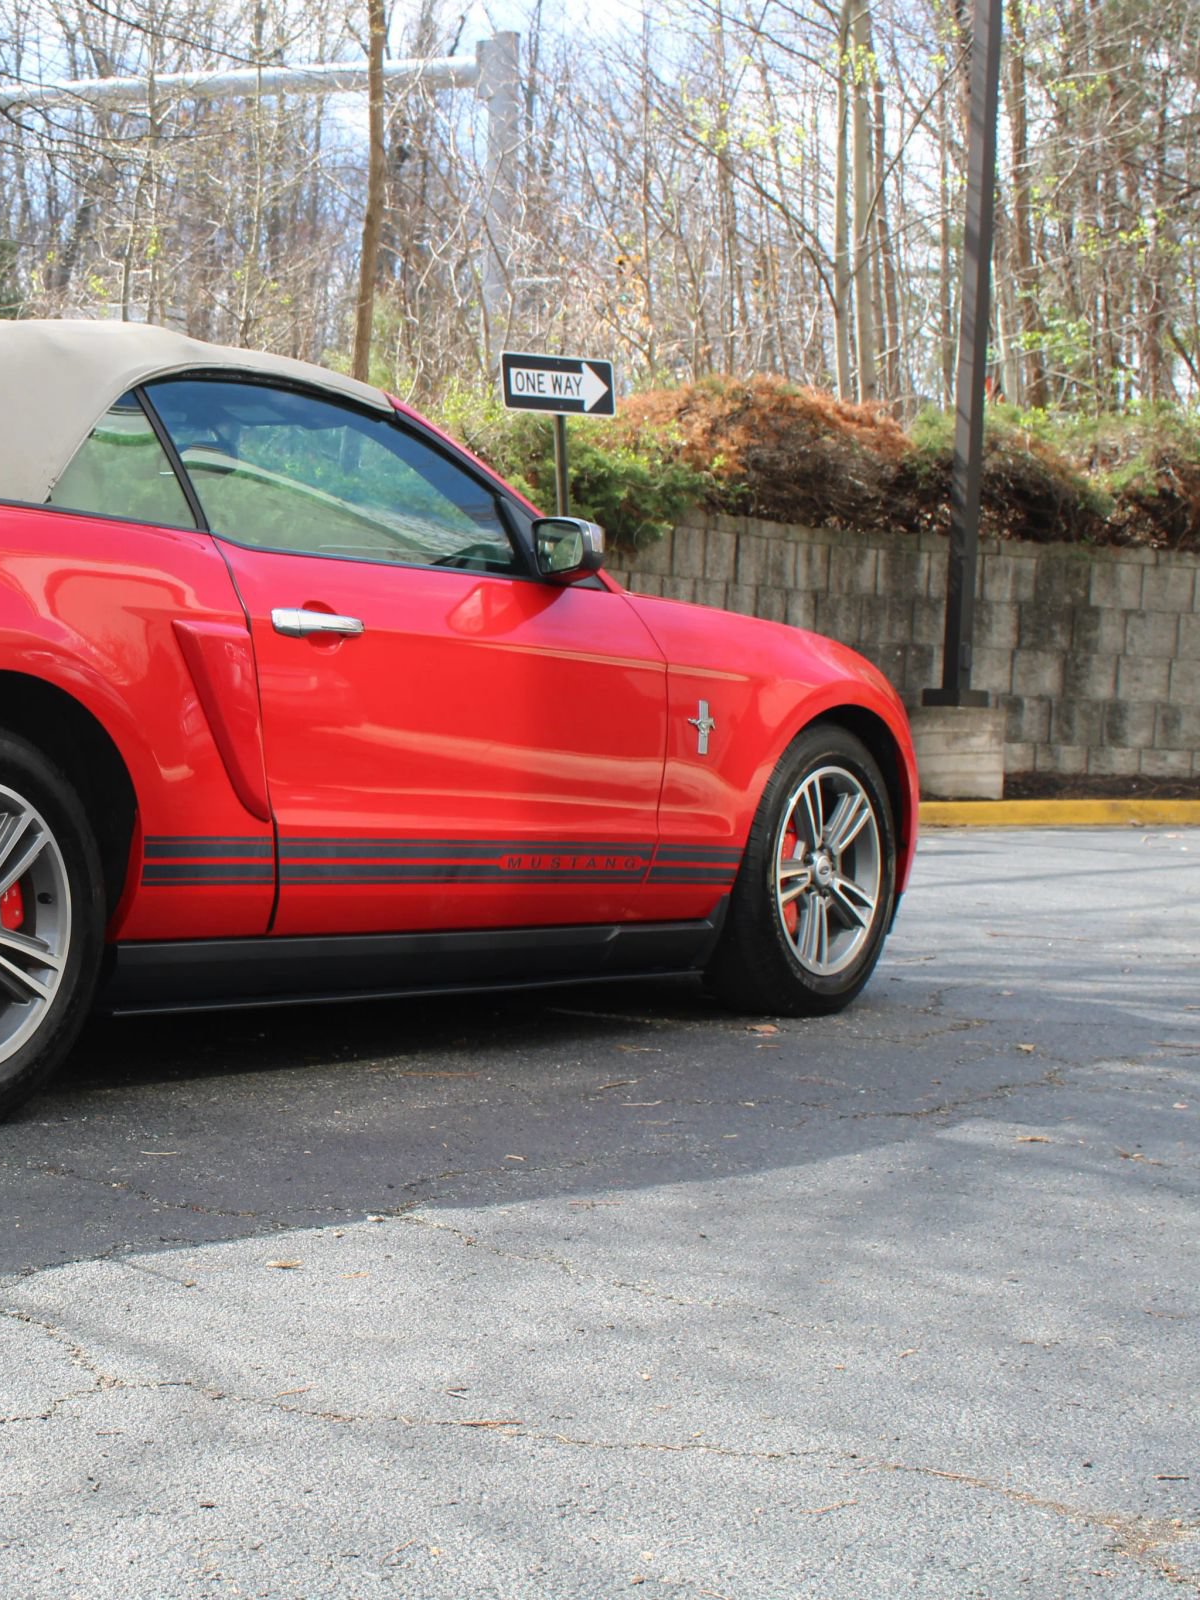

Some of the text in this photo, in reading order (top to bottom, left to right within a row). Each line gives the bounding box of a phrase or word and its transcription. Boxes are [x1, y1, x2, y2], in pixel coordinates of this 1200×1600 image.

[515, 371, 582, 396] ONE WAY
[506, 858, 636, 870] MUSTANG
